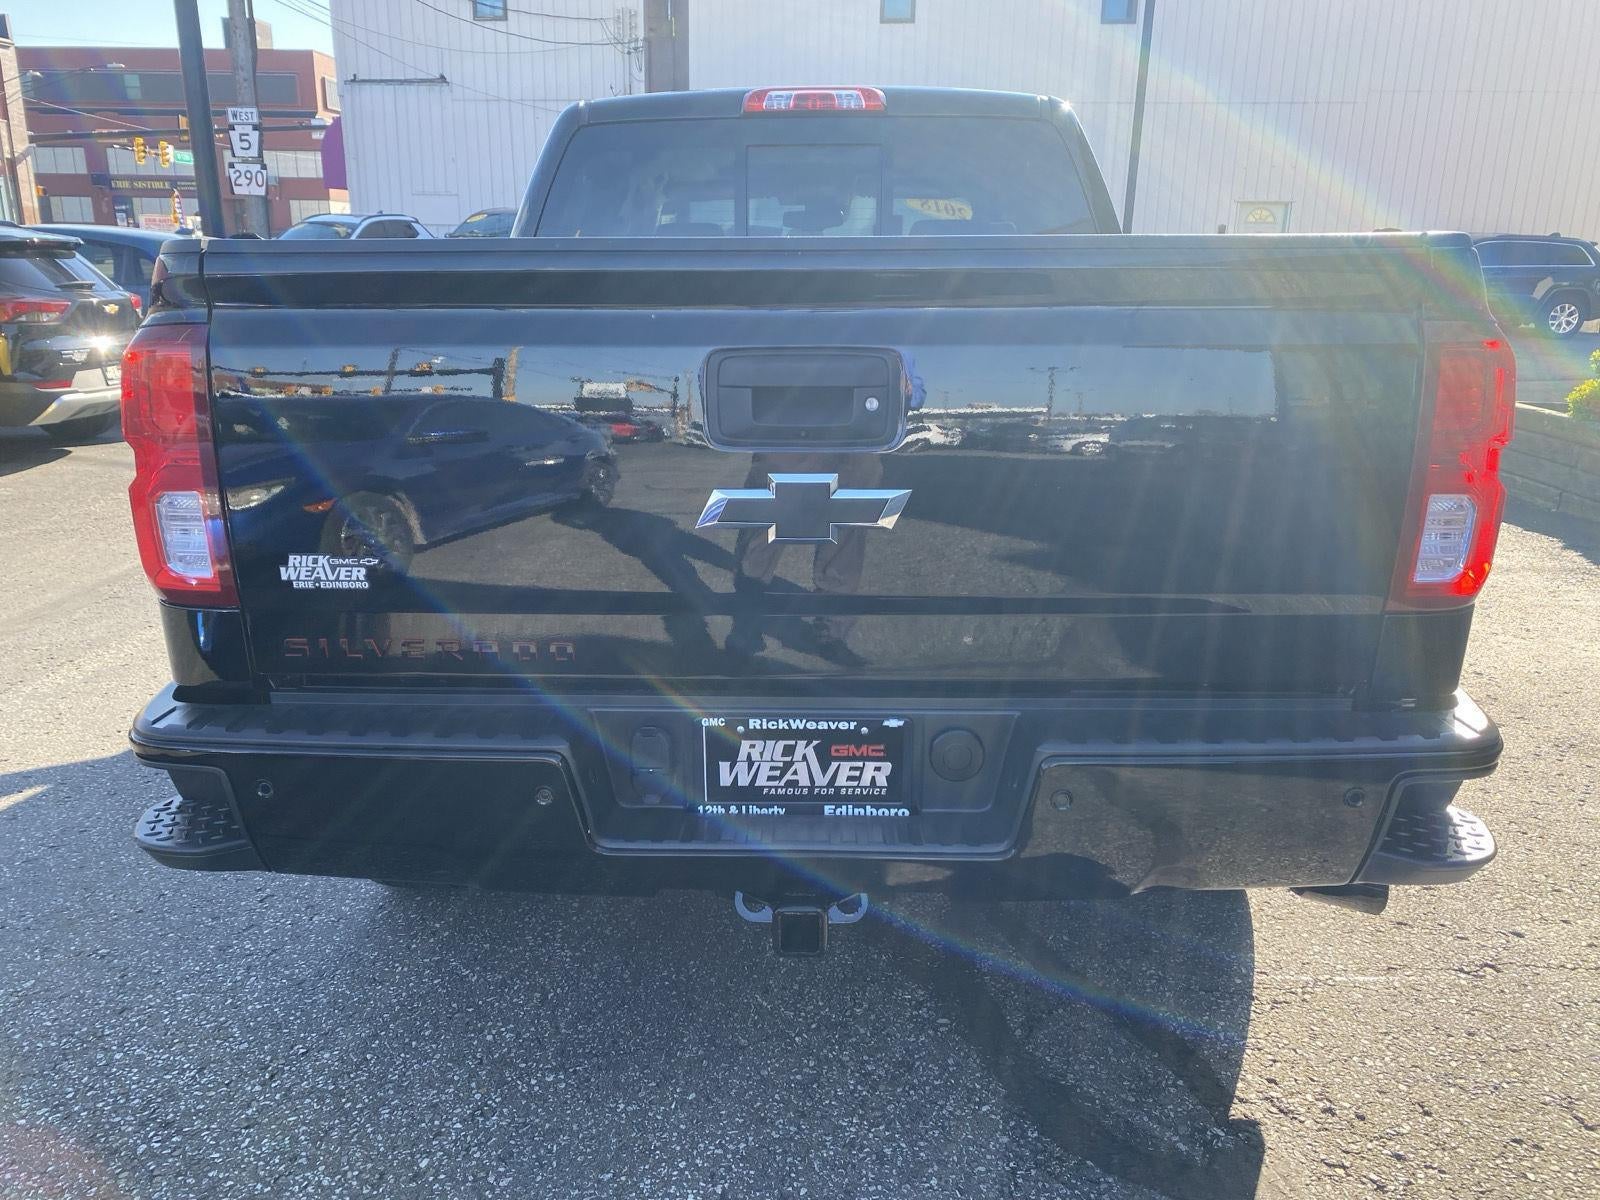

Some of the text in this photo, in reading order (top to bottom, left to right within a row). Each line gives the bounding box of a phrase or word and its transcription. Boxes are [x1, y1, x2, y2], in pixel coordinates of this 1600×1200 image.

[231, 110, 254, 120] WEST
[239, 133, 252, 150] 5
[233, 169, 265, 187] 290
[288, 555, 330, 567] RICK
[279, 566, 366, 581] WEAVER
[320, 581, 369, 589] EDINBORO
[284, 637, 577, 661] SILVERADO
[701, 717, 858, 731] GMC RickWeaver
[737, 739, 886, 762] RICK GMC
[718, 761, 893, 787] WEAVER
[840, 788, 887, 796] SERVICE
[697, 805, 726, 814] 12th
[729, 805, 739, 815] &
[823, 804, 910, 817] Edinboro
